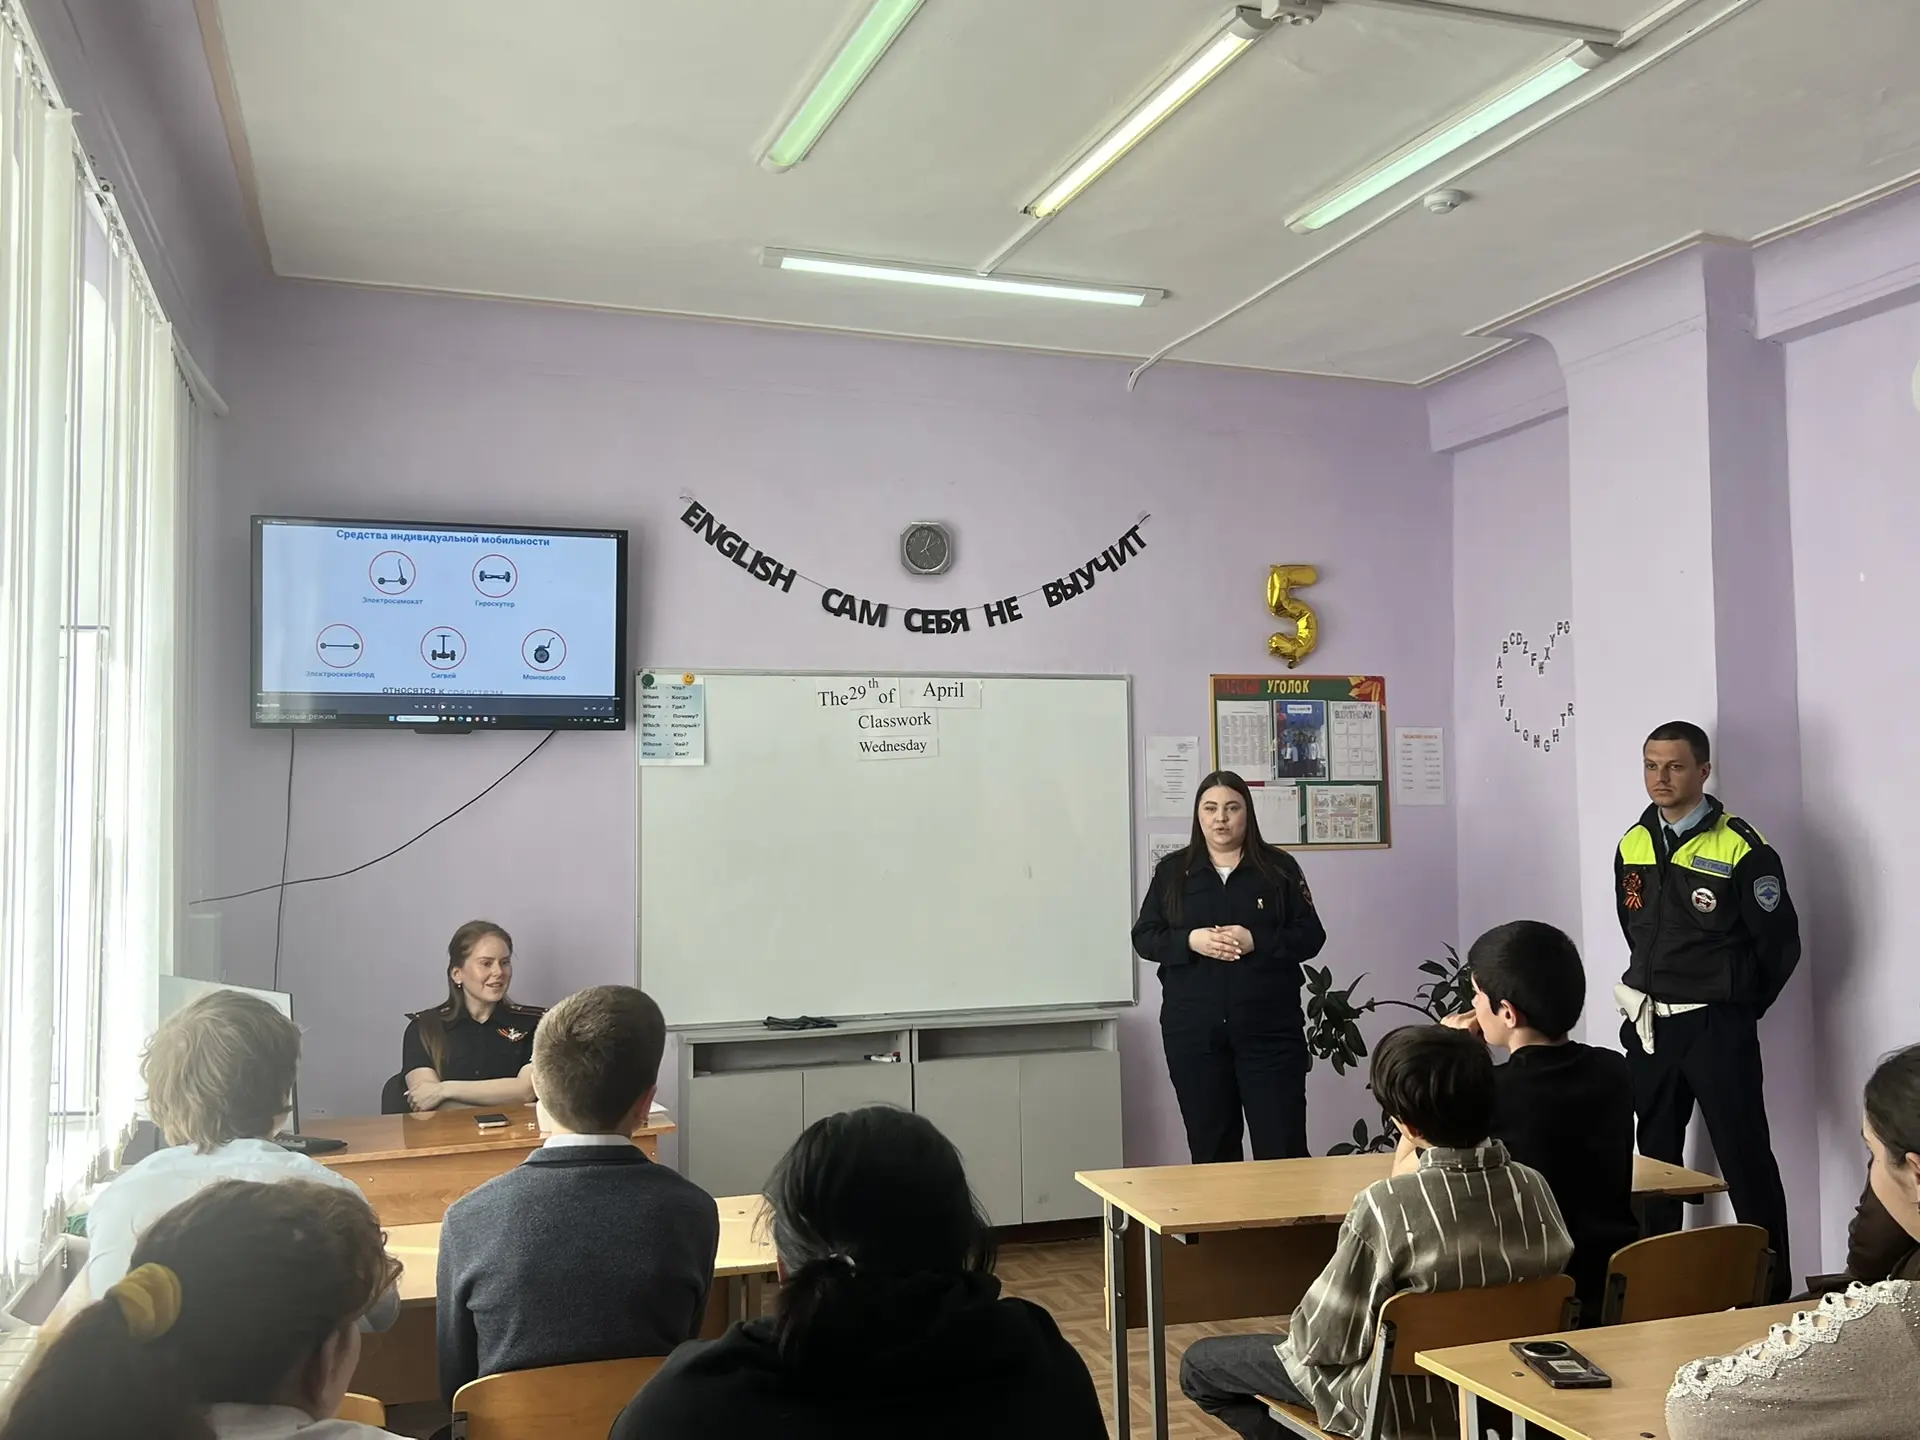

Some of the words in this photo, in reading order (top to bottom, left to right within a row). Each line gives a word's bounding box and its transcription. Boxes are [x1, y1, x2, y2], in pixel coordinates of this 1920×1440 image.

[336, 529, 388, 541] Средства
[391, 532, 478, 544] индивидуальной
[482, 535, 550, 546] мобильности
[681, 501, 796, 592] ENGLISH
[822, 589, 888, 627] САМ
[904, 608, 969, 634] СЕБЯ
[984, 596, 1023, 627] НЕ
[1042, 525, 1146, 607] ВЫУЧИТ
[475, 600, 515, 608] Гироскутер
[1267, 564, 1319, 664] 5
[431, 672, 456, 680] Сигвей
[817, 690, 849, 706] The
[878, 687, 897, 704] of
[922, 681, 964, 701] April
[1267, 679, 1310, 694] УГОЛОК
[858, 712, 932, 730] Classwork
[859, 739, 928, 754] Wednesday
